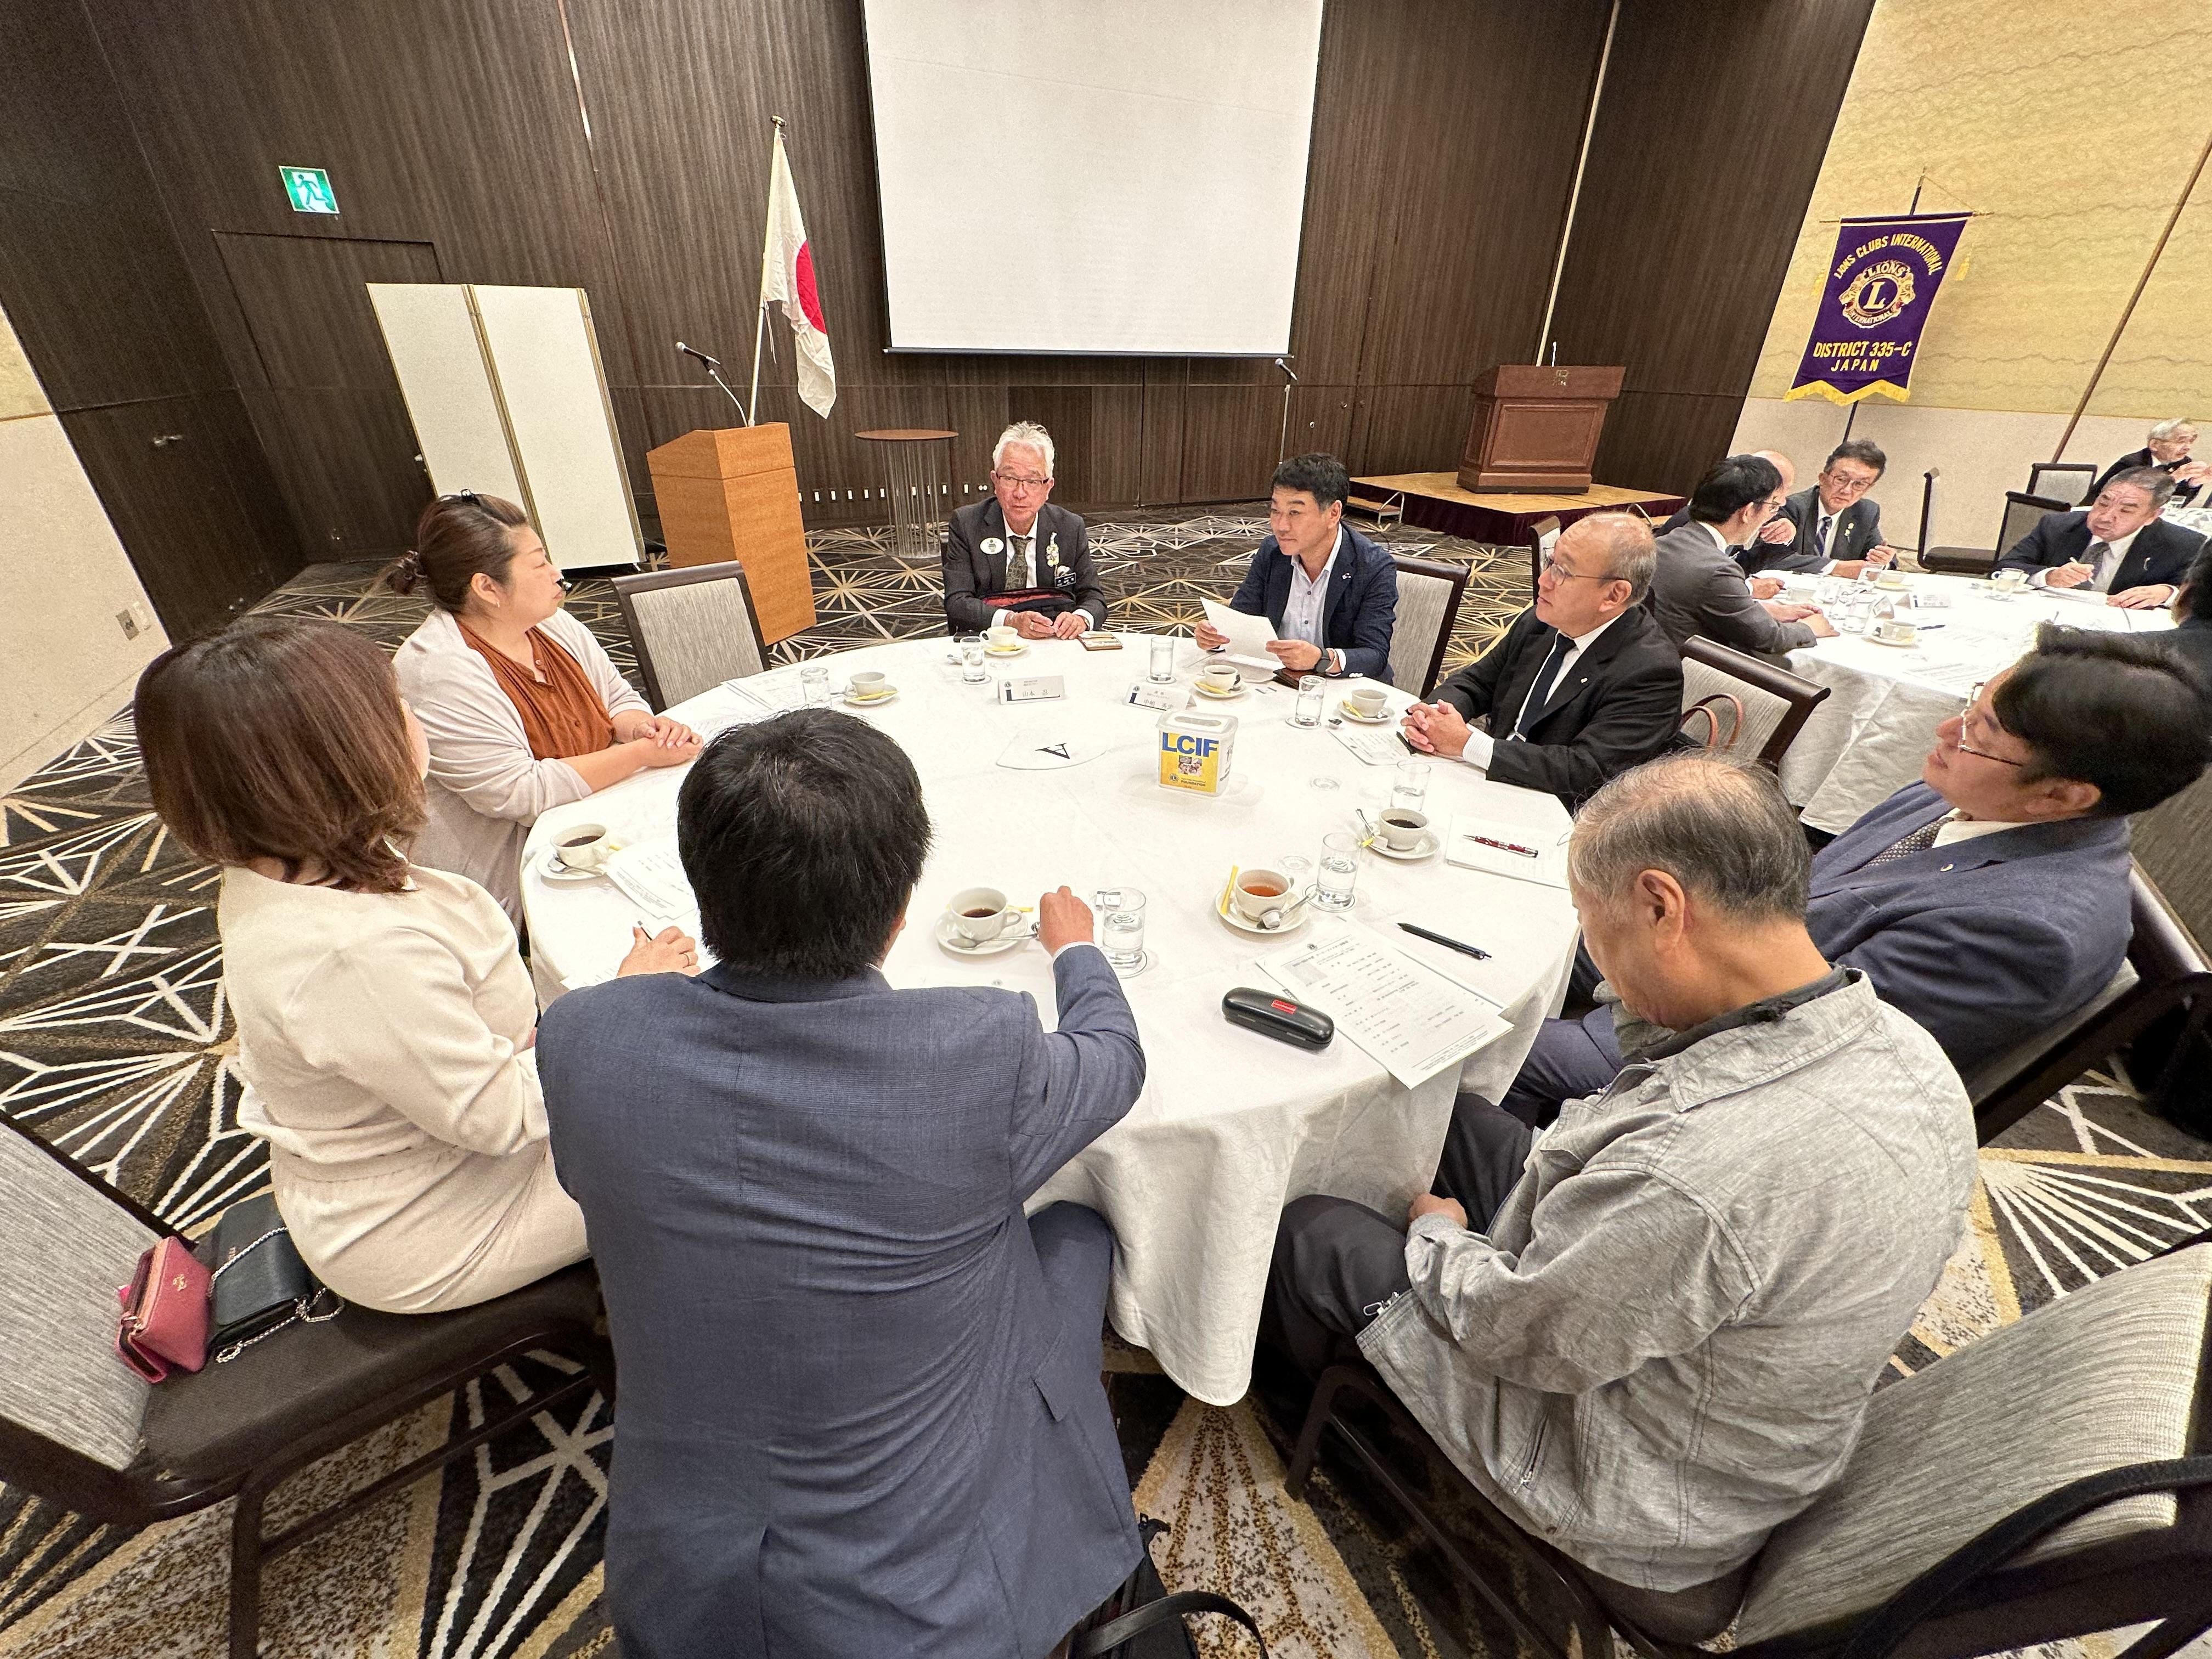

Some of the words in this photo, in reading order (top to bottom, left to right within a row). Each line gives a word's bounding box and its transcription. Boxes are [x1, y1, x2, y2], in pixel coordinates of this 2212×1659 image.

[1834, 255, 1856, 279] LIONS
[1855, 236, 1889, 258] CLUBS
[1891, 233, 1943, 275] INTERNATIONAL
[1867, 262, 1906, 278] LIONS
[1863, 281, 1886, 309] L
[1813, 341, 1870, 357] DISTRICT
[1869, 341, 1912, 357] 335-C
[1831, 359, 1880, 372] JAPAN
[1035, 742, 1070, 759] A
[1163, 732, 1219, 757] LCIF
